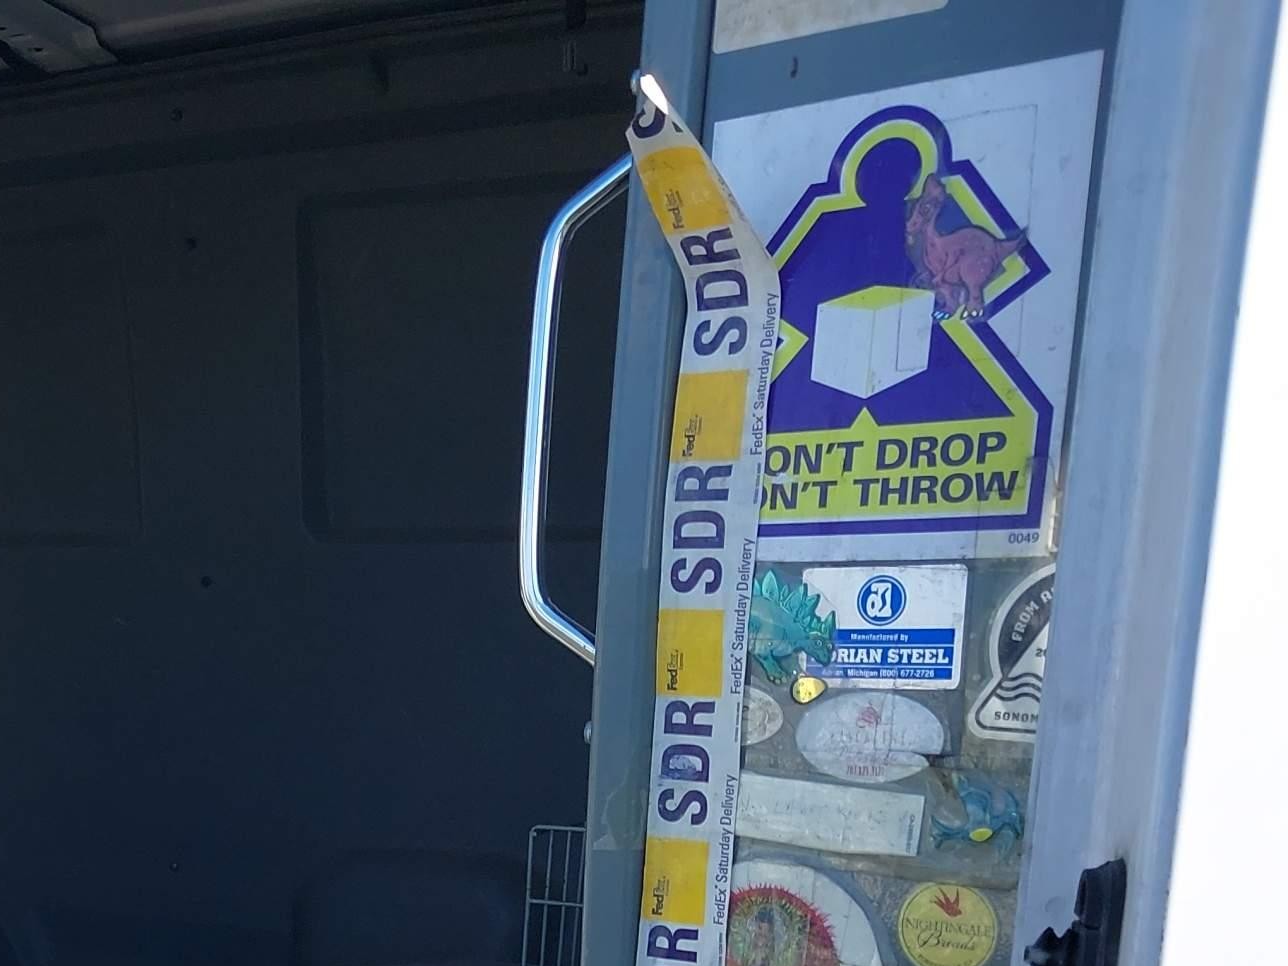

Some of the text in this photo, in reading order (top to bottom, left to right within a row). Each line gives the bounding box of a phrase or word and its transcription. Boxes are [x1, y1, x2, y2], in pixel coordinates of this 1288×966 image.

[679, 226, 749, 356] SDR
[759, 292, 779, 348] Delivery
[753, 350, 773, 410] Saturday
[764, 431, 1008, 477] ON'T DROP
[853, 470, 1020, 508] THROW
[670, 463, 734, 595] SDR
[1007, 532, 1040, 545] 0049
[736, 537, 755, 592] Delivery
[731, 593, 750, 652] Saturday
[900, 633, 909, 643] by
[1011, 600, 1040, 643] FROM
[832, 648, 949, 664] RIAN STEEL
[847, 668, 878, 678] Michigan
[994, 711, 1039, 723] SONOM
[657, 700, 716, 826] SDR
[719, 774, 737, 827] Delivery
[715, 828, 733, 884] Saturday
[905, 917, 993, 937] NIGHTINGALE
